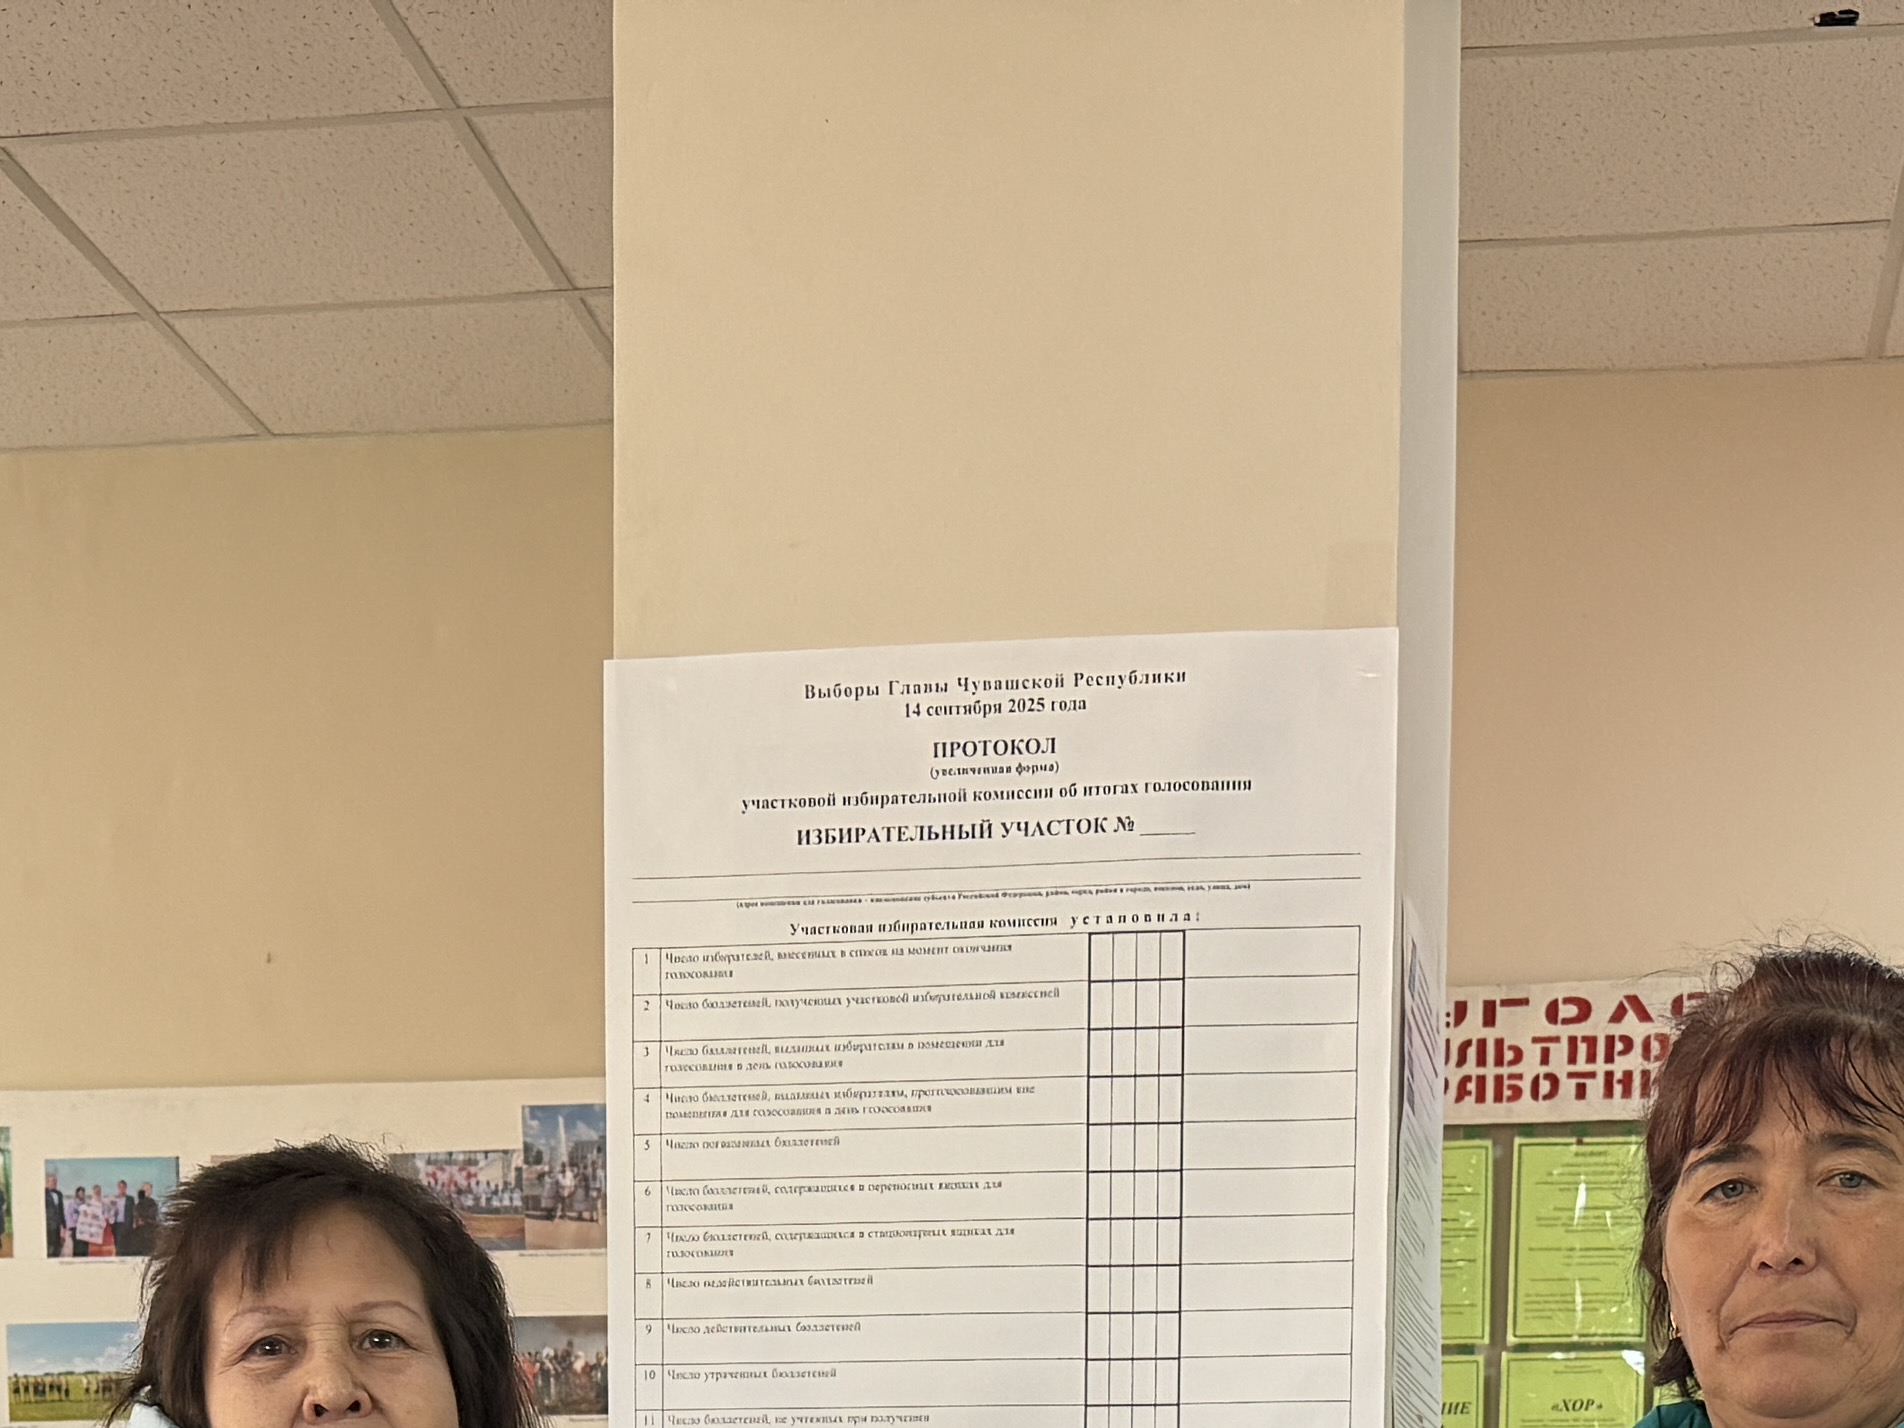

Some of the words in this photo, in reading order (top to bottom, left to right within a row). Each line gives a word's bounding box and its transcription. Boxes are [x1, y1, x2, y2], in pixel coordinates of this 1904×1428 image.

[804, 682, 880, 702] Выборы
[888, 680, 948, 696] Главы
[957, 673, 1065, 695] Чувашской
[1073, 669, 1186, 690] Республики
[905, 702, 921, 718] 14
[926, 699, 1002, 718] сентября
[1007, 697, 1046, 713] 2025
[1050, 699, 1087, 712] года
[933, 737, 1056, 758] ПРОТОКОЛ
[741, 793, 836, 815] участковой
[842, 788, 967, 809] избирательной
[972, 787, 1054, 802] комиссии
[1059, 782, 1078, 798] об
[1083, 783, 1139, 797] итогах
[1144, 779, 1252, 794] голосования
[797, 819, 993, 846] ИЗБИРАТЕЛЬНЫЙ
[1000, 816, 1108, 839] УЧАСТОК
[1112, 816, 1135, 833] №
[644, 952, 649, 966] 1
[643, 998, 650, 1012] 2
[643, 1045, 650, 1058] 3
[1444, 1069, 1652, 1104] АБОТН
[643, 1093, 650, 1105] 4
[643, 1138, 651, 1152] 5
[644, 1184, 652, 1197] 6
[645, 1277, 652, 1290] 8
[645, 1323, 653, 1336] 9
[644, 1368, 657, 1382] 10
[644, 1413, 655, 1428] 11
